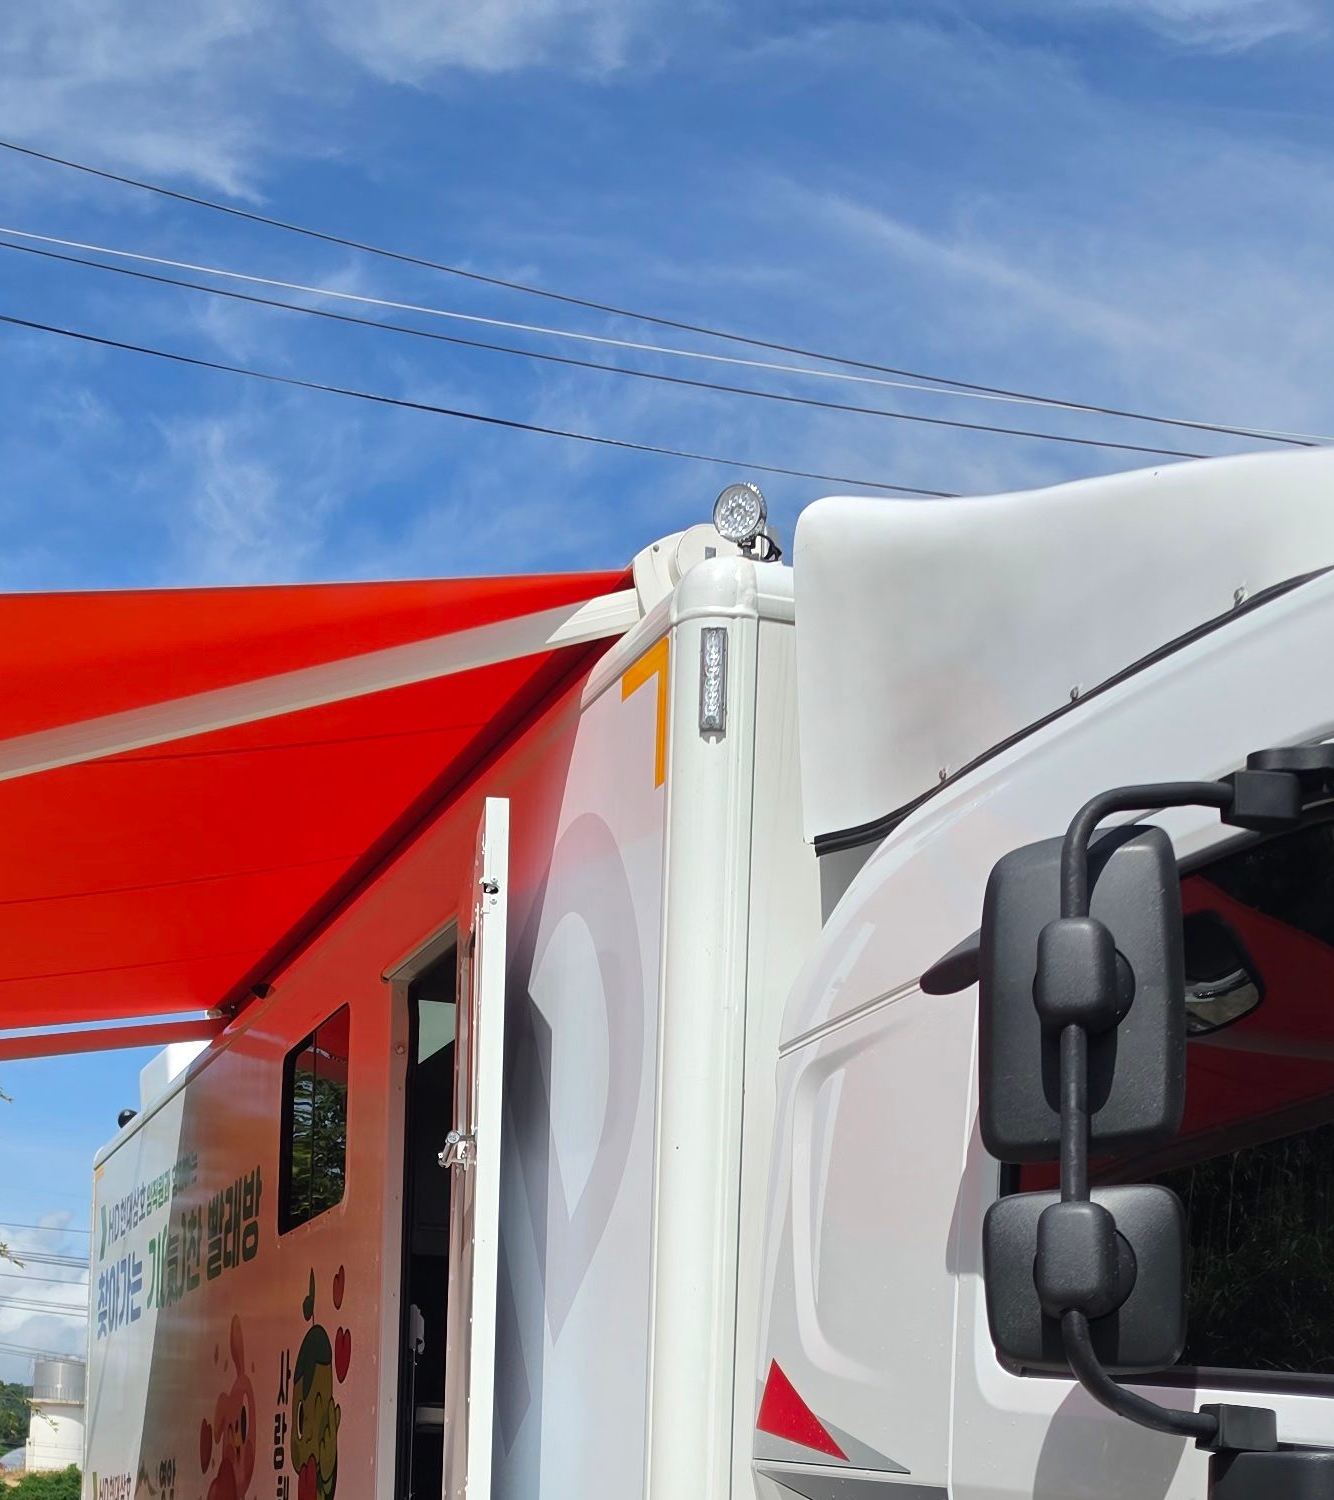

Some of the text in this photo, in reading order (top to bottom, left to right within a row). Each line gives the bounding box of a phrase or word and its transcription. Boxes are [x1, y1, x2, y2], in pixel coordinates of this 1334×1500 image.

[98, 1251, 143, 1340] 찾아가는
[207, 1165, 262, 1281] 빨래방
[108, 1181, 146, 1246] HD현대삼호
